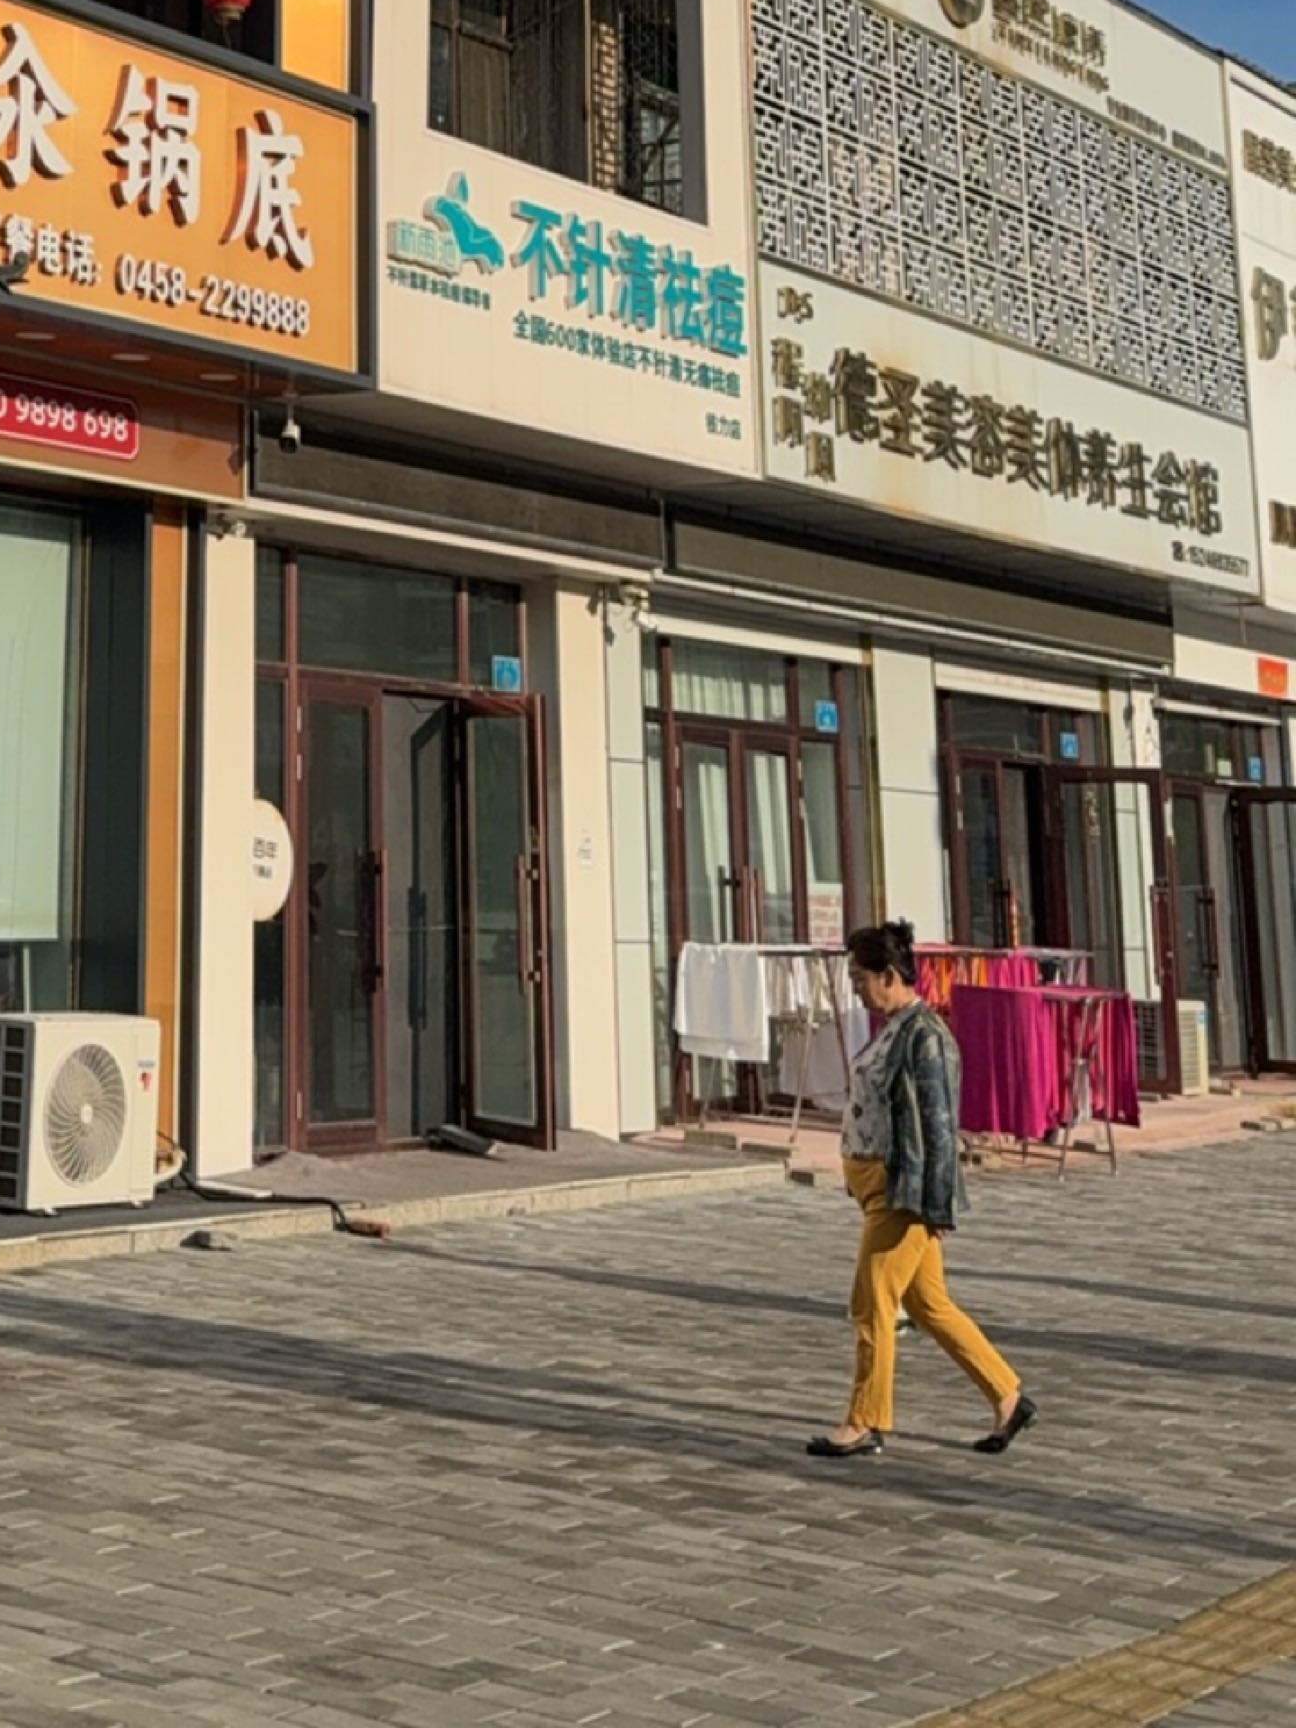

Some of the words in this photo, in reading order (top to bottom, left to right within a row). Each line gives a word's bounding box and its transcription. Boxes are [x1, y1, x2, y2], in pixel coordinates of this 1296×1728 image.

[511, 200, 747, 358] 不针清祛痘
